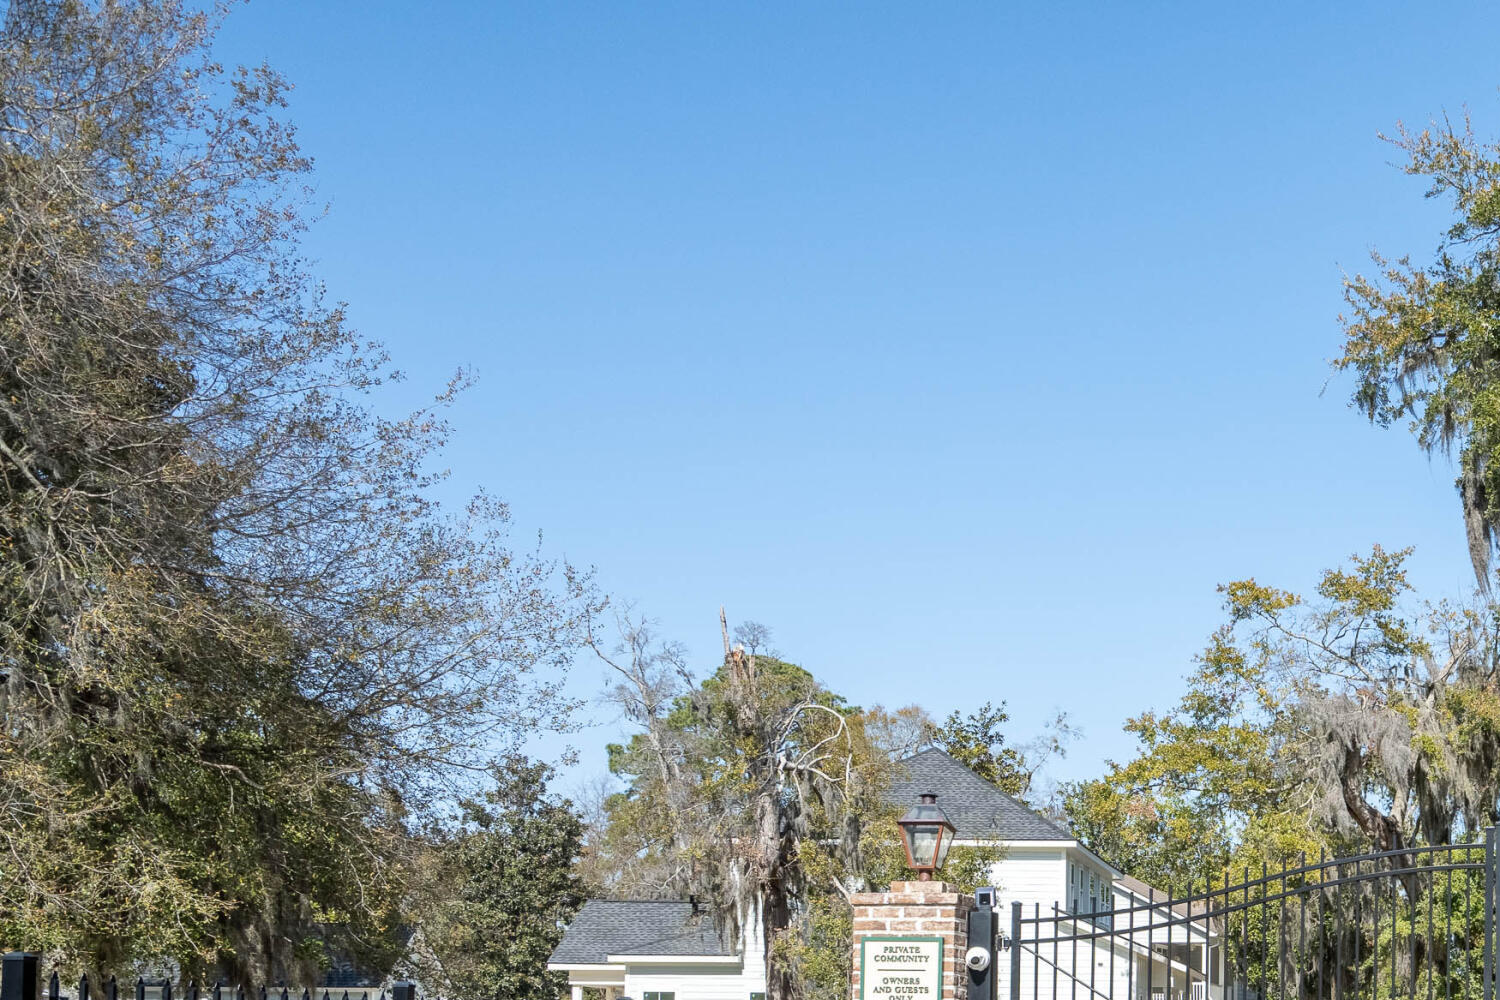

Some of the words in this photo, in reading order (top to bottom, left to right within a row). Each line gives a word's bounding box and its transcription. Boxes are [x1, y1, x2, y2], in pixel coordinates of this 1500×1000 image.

[883, 946, 921, 954] PRIVATE
[873, 955, 930, 963] COMMUNITY
[882, 977, 921, 985] OWNERS
[872, 986, 892, 994] AND
[894, 986, 930, 994] GUESTS
